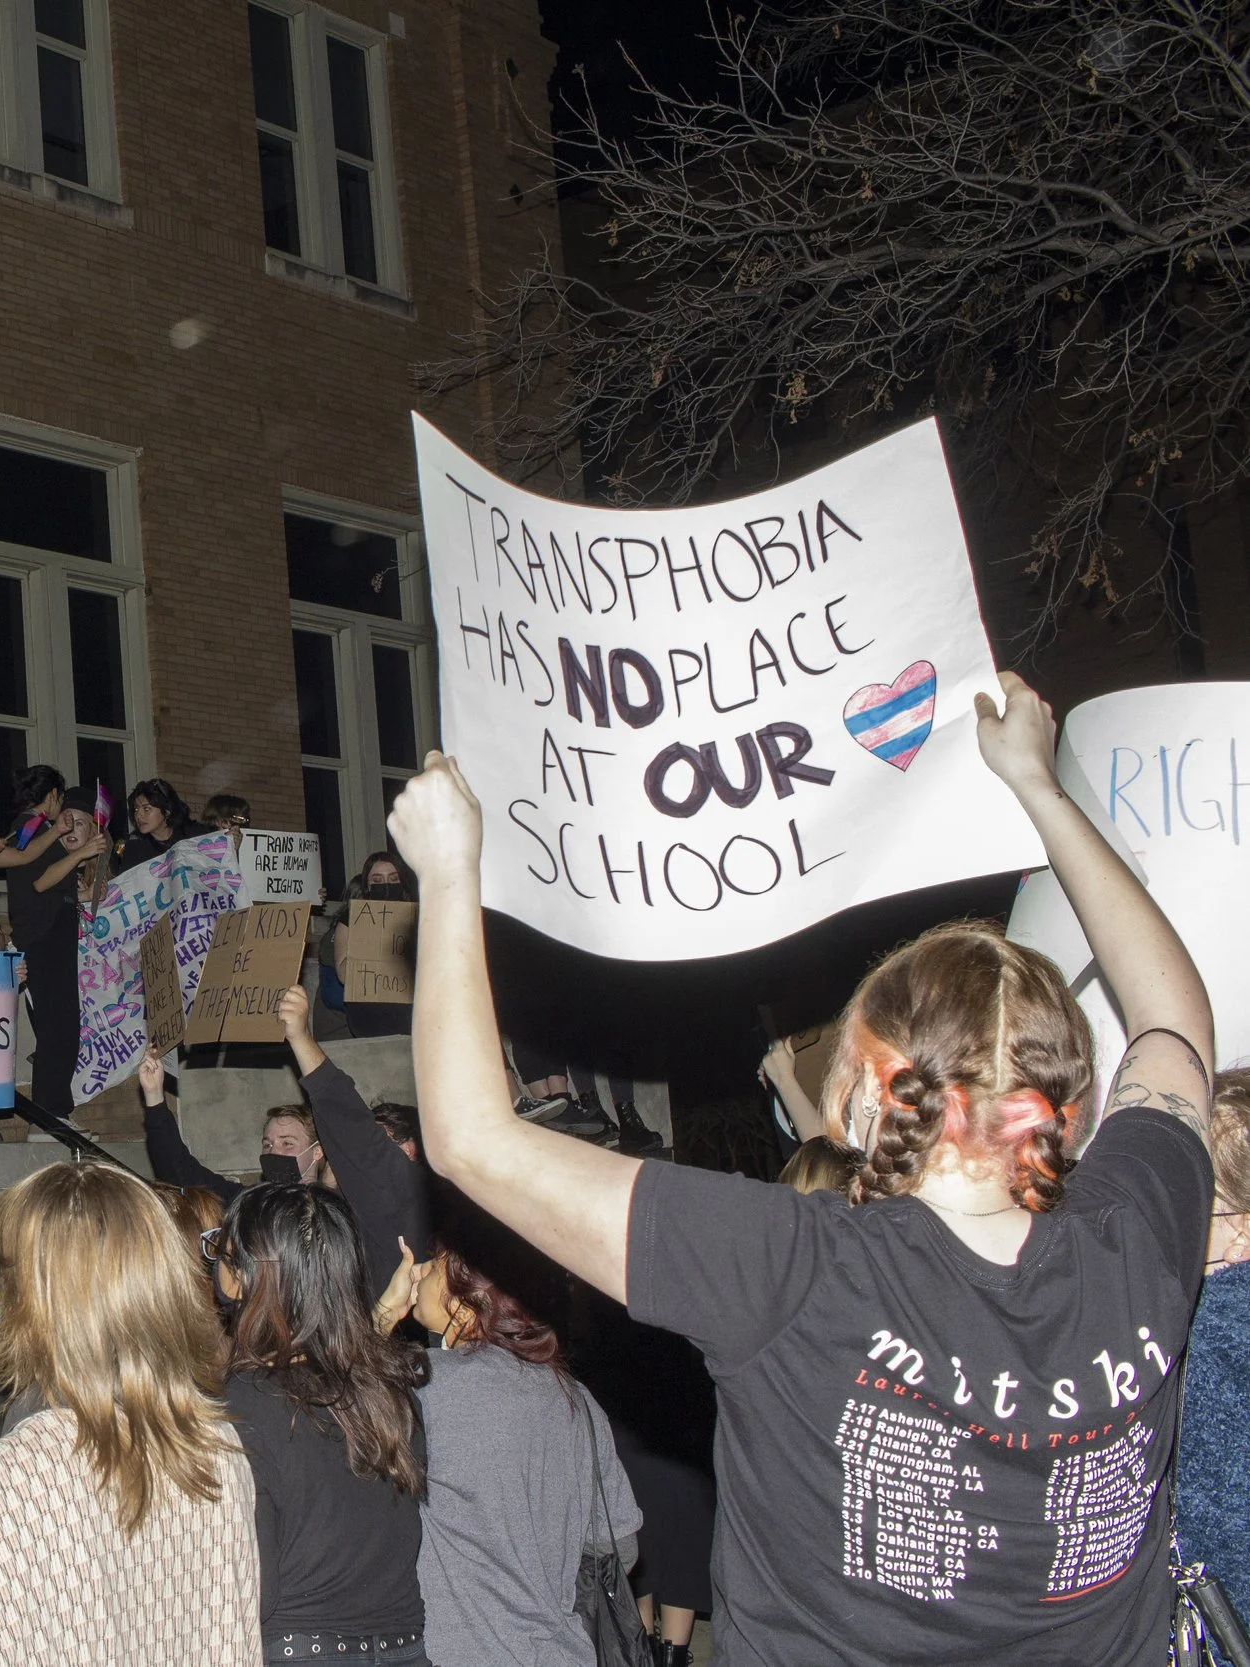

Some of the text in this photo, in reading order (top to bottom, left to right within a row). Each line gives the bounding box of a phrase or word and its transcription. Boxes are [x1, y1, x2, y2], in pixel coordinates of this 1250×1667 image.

[446, 472, 863, 620] TRANSPHOBIA
[457, 586, 876, 730] HAS NO PLACE
[541, 720, 836, 818] AT OUR
[246, 834, 319, 853] TRANS RIGHTS
[507, 799, 847, 911] SCHOOL
[255, 855, 308, 871] ARE HUMAN
[267, 877, 304, 894] RIGHTS
[213, 910, 248, 949] LET
[255, 908, 302, 939] KIDS
[232, 949, 254, 974] BE
[198, 984, 288, 1019] THEMSELVE
[82, 1029, 146, 1095] SHE/HER
[866, 1326, 1171, 1420] mitski
[841, 1411, 958, 1448] 2.18 Raleigh, NC
[845, 1398, 972, 1439] 2.17 Asheville, NC
[837, 1423, 952, 1460] 2.19 Atlanta, GA
[1049, 1423, 1113, 1448] Tour
[1053, 1421, 1141, 1467] 3.12 Denver, CO
[834, 1435, 981, 1478] 2.21 Birmingham, AL
[1051, 1466, 1080, 1477] 3.14
[1084, 1460, 1100, 1471] St.
[1105, 1444, 1132, 1463] Paul,
[1132, 1426, 1146, 1445] MN
[866, 1458, 896, 1475] New
[900, 1467, 960, 1490] Orleans,
[965, 1480, 984, 1493] LA
[875, 1486, 928, 1506] Austin,
[933, 1487, 951, 1500] TX
[1045, 1497, 1072, 1508] 3.19
[842, 1496, 999, 1537] 3.2 Los Angeles, CA
[944, 1510, 964, 1522] AZ
[1044, 1508, 1071, 1520] 3.21
[1076, 1500, 1124, 1517] Boston,
[841, 1510, 998, 1550] 3.3 Los Angeles, CA
[1057, 1523, 1085, 1536] 3.25
[876, 1532, 939, 1554] Oakland,
[944, 1546, 966, 1557] CA
[1055, 1547, 1082, 1558] 3.27
[875, 1556, 939, 1576] Portland,
[944, 1570, 966, 1580] OR
[876, 1545, 938, 1566] Oakland,
[944, 1558, 965, 1570] CA
[1052, 1558, 1079, 1568] 3.29
[843, 1566, 872, 1580] 3.10
[932, 1589, 955, 1600] WA
[931, 1577, 953, 1587] WA
[1047, 1581, 1073, 1591] 3.31
[1048, 1568, 1075, 1579] 3.30
